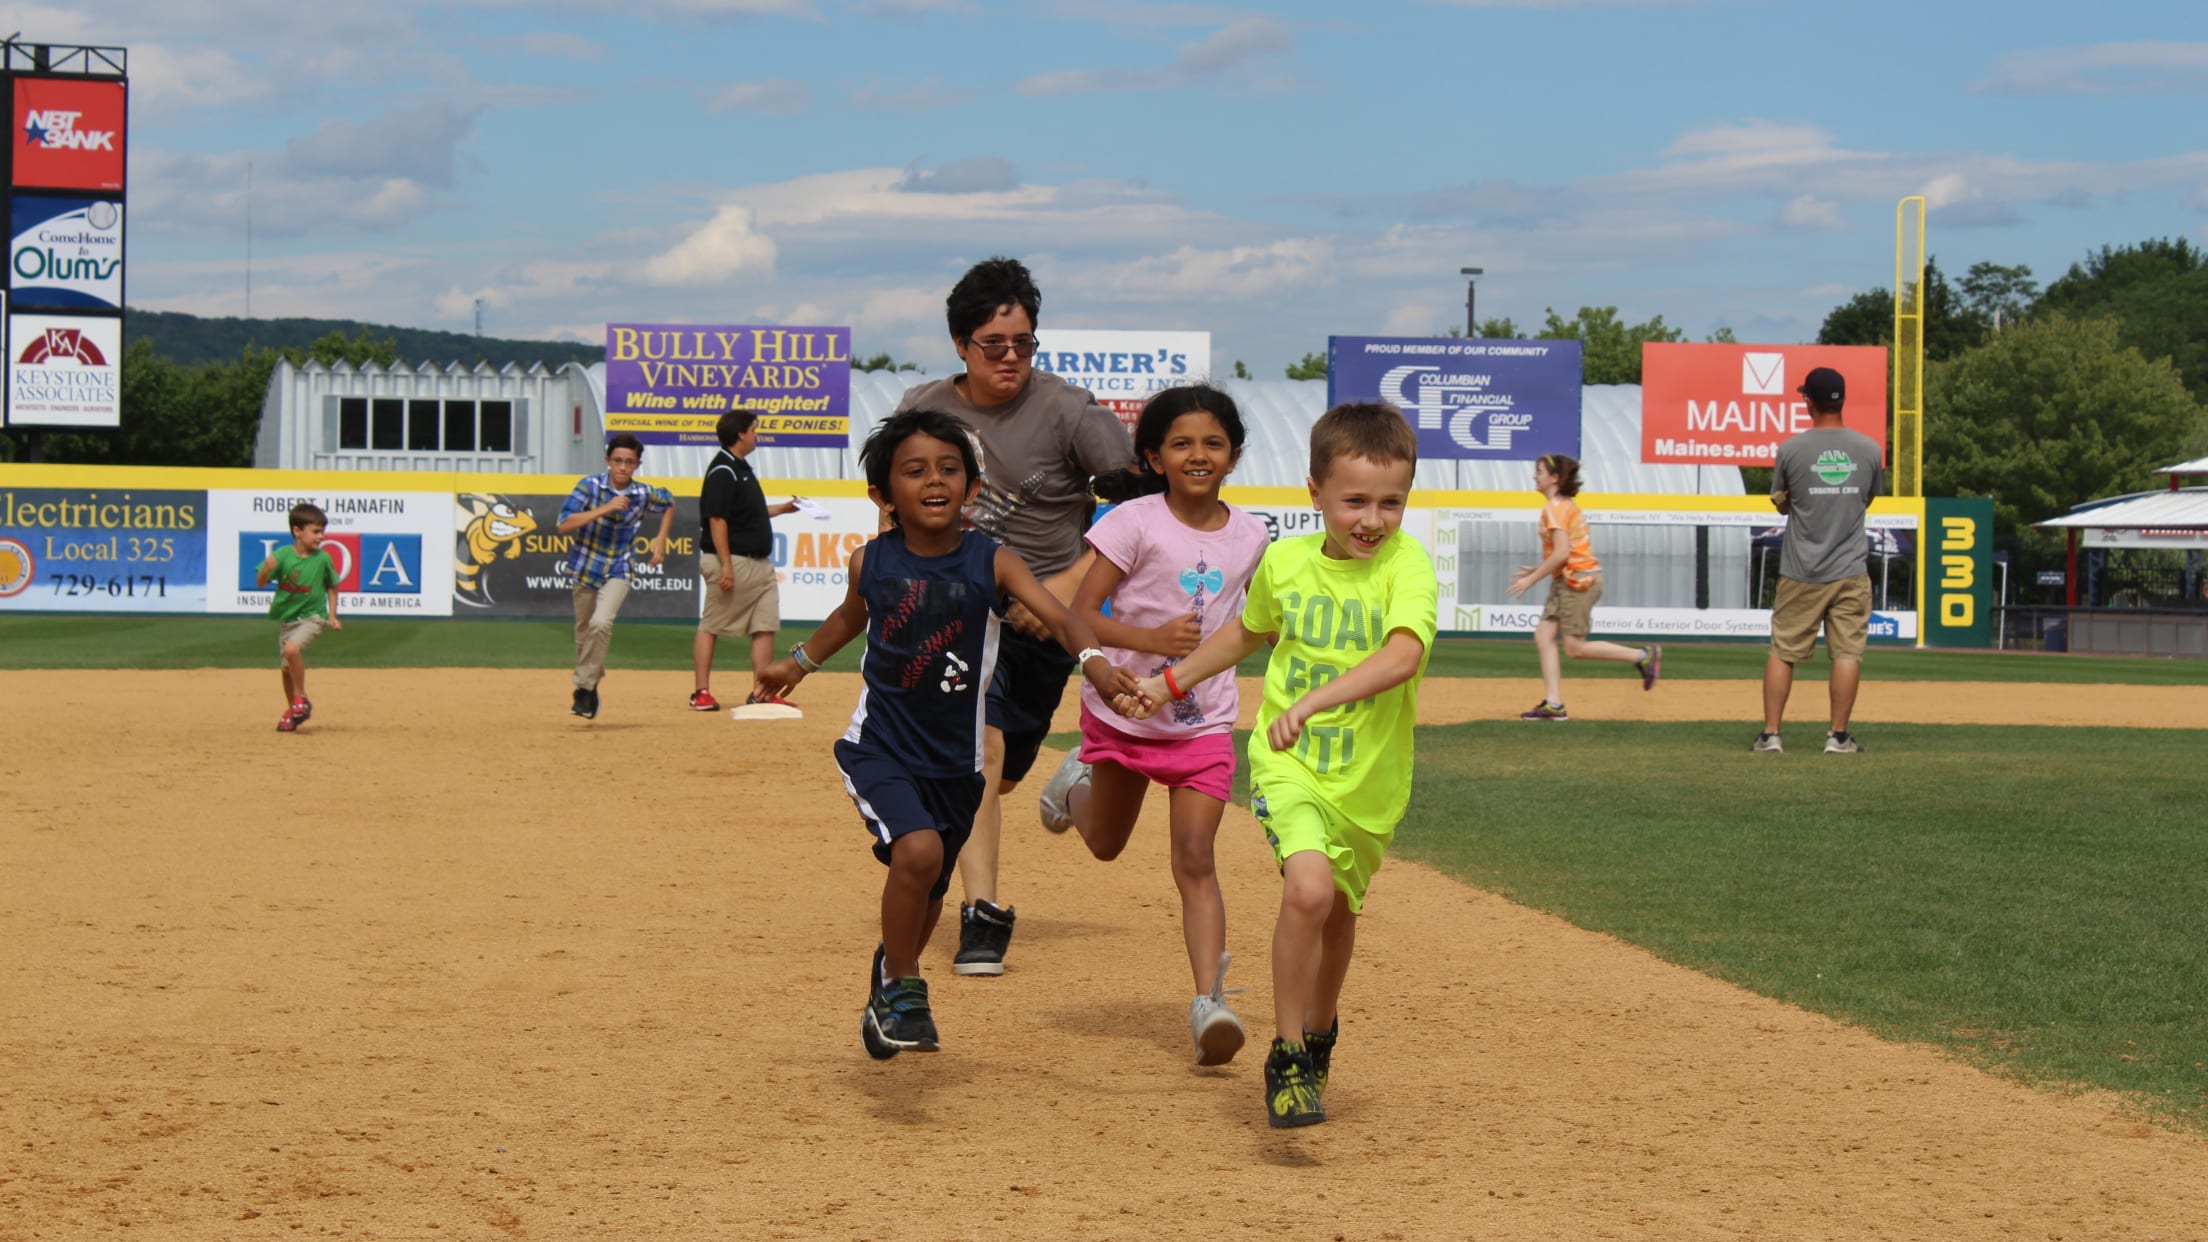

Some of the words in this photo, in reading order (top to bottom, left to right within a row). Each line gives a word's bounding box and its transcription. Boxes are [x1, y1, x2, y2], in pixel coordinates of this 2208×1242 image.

[26, 109, 82, 129] NBT
[41, 130, 115, 151] BANK
[13, 246, 121, 280] Olum's
[612, 327, 741, 361] BULLY
[751, 329, 847, 363] HILL
[1365, 343, 1400, 354] PROUD
[1402, 344, 1446, 355] MEMBER
[1447, 345, 1463, 355] OF
[1464, 345, 1486, 356] OUR
[1488, 346, 1549, 357] COMMUNITY
[1035, 349, 1187, 375] ARNER'S
[16, 369, 114, 387] KEYSTONE
[638, 361, 821, 389] VINEYARDS
[1067, 377, 1135, 391] RVICE
[1418, 373, 1491, 387] COLUMBIAN
[15, 386, 115, 403] ASSOCIATES
[626, 391, 676, 409] Wine
[682, 393, 727, 410] with
[731, 395, 831, 414] Laughter!
[1449, 393, 1515, 406] FINANCIAL
[610, 418, 651, 427] OFFICIAL
[655, 419, 678, 427] WINE
[682, 420, 694, 428] OF
[697, 420, 715, 428] THE
[783, 420, 844, 431] PONIES!
[1488, 413, 1533, 426] GROUP
[1686, 399, 1814, 433] MAINE
[0, 492, 195, 530] lectricians
[335, 498, 405, 514] HANAFIN
[45, 536, 117, 561] Local
[127, 538, 175, 563] 325
[793, 571, 826, 585] FOR
[1941, 516, 1976, 628] 330
[50, 573, 167, 598] 729-6171
[352, 596, 366, 609] OF
[370, 597, 422, 609] AMERICA
[1591, 617, 1635, 629] Interior
[1635, 618, 1645, 629] &
[1648, 618, 1691, 630] Exterior
[1694, 619, 1722, 631] Door
[1725, 620, 1770, 632] Systems
